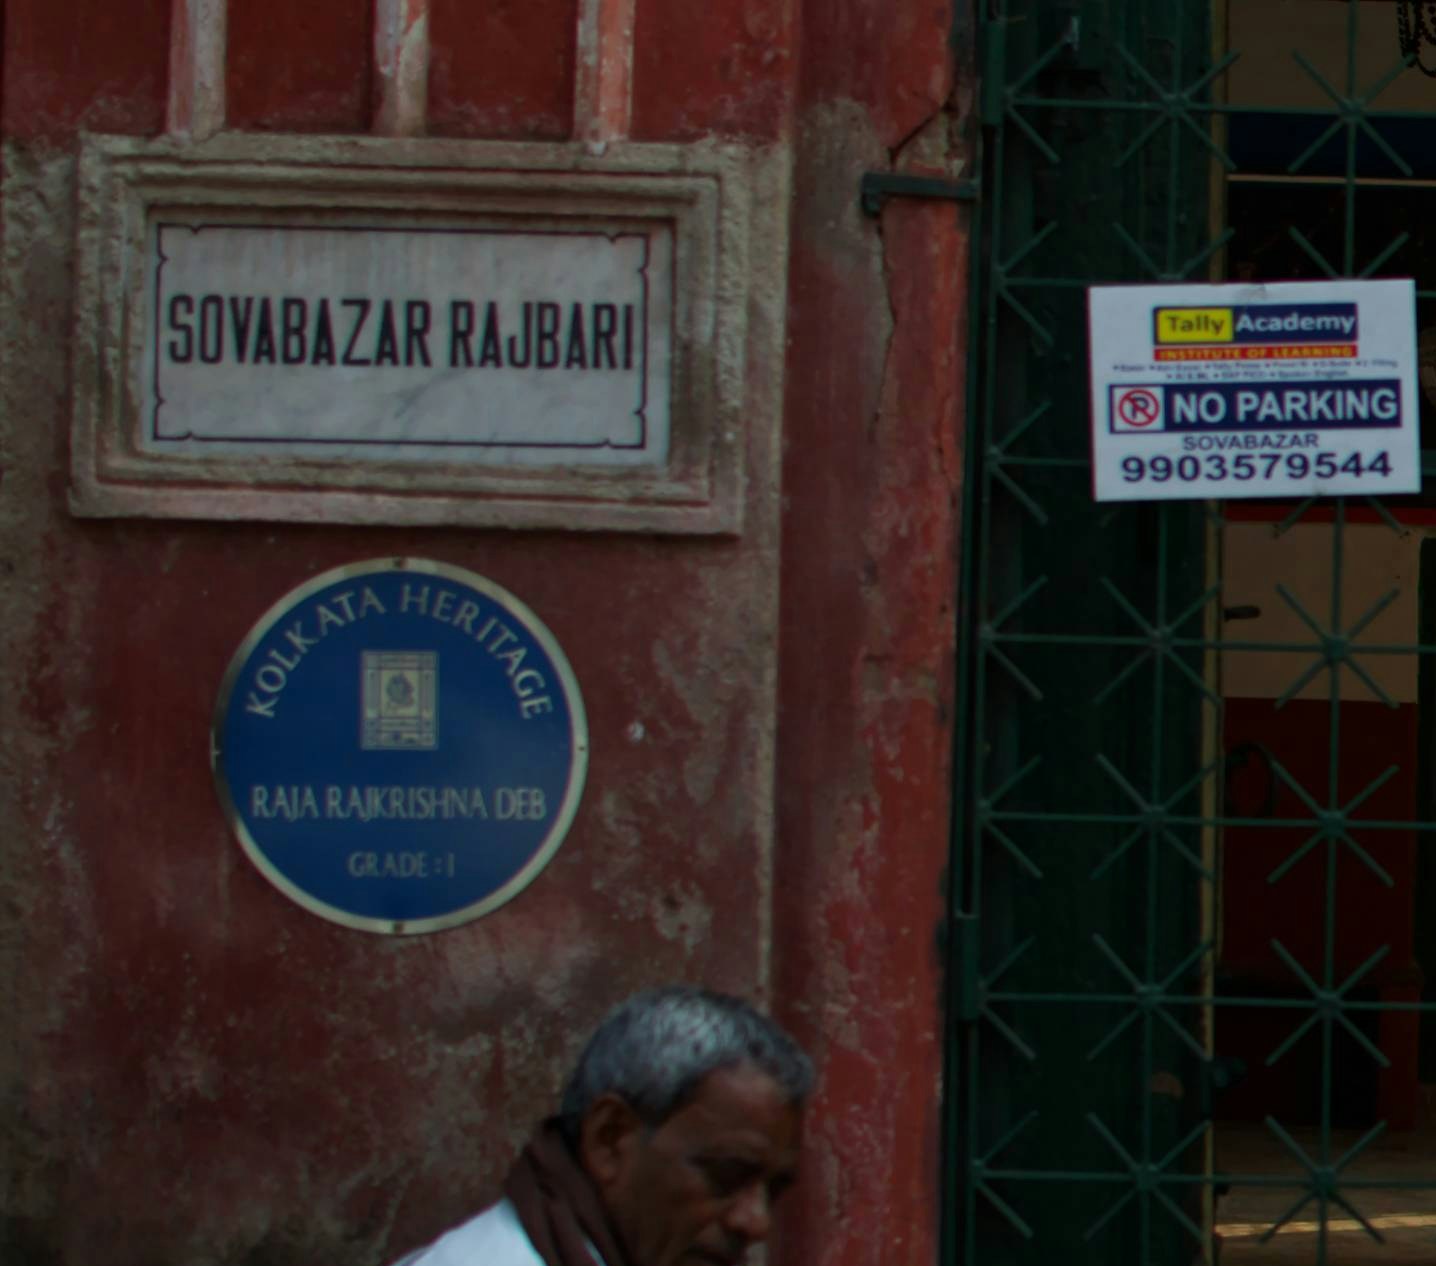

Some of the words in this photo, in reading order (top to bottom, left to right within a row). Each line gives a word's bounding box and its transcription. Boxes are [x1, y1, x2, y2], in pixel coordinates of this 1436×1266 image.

[167, 294, 433, 368] SOVABAZAR
[448, 299, 634, 372] RAJBARI
[1167, 313, 1225, 336] Tally
[1235, 312, 1357, 334] Academy
[1159, 347, 1240, 360] INSTITUTE
[1247, 347, 1268, 358] OF
[1272, 345, 1353, 358] LEARNING
[1172, 391, 1227, 424] NO
[1236, 388, 1398, 423] PARKING
[1182, 432, 1320, 452] SOVABAZAR
[1121, 450, 1393, 484] 9903579544
[245, 586, 388, 719] KOLKATA
[400, 583, 554, 720] HERITAGE
[251, 785, 319, 823] RAJA
[325, 785, 489, 823] RAJKRISHNA
[494, 787, 547, 821] DEB
[346, 851, 428, 878] GRADE
